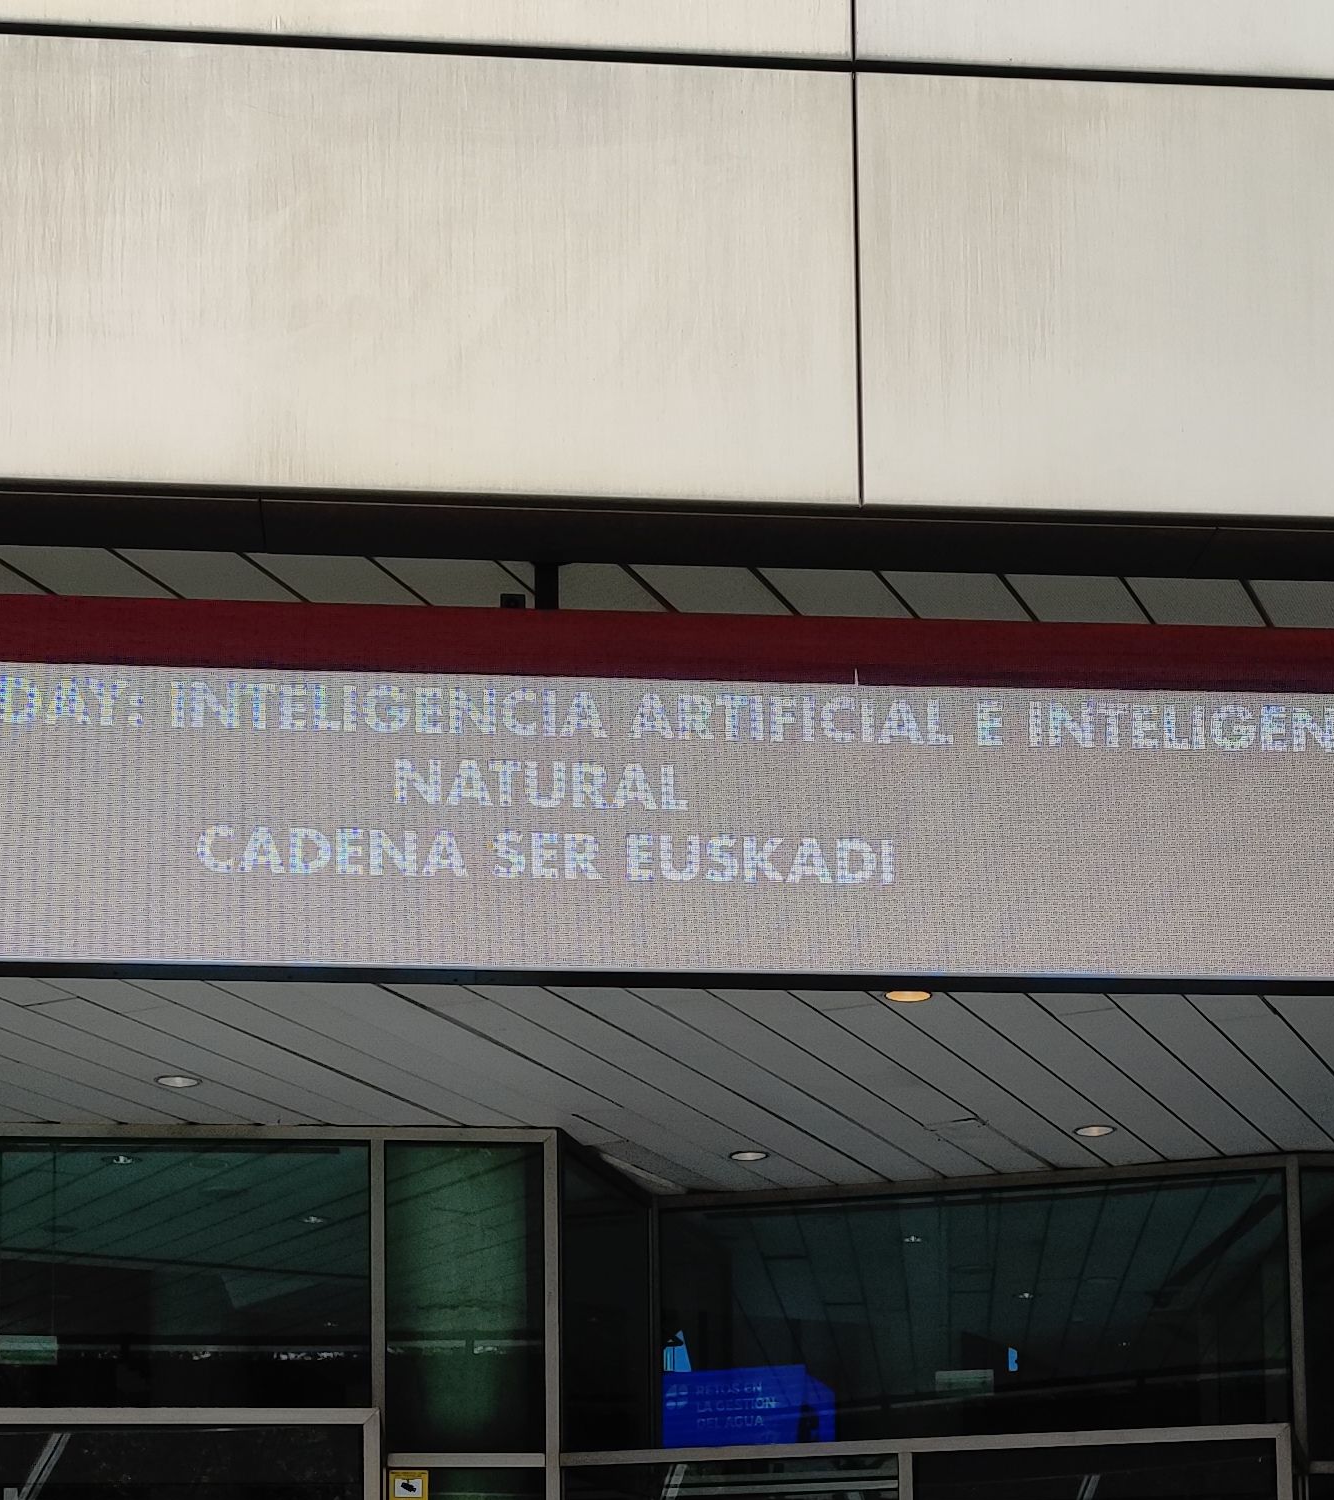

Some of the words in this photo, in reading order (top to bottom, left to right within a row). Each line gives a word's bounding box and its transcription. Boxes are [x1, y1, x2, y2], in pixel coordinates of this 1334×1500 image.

[171, 681, 607, 739] INTELIGENCIA
[629, 693, 954, 745] ARTIFICIAL
[977, 700, 1004, 747] E
[394, 758, 688, 811] NATURAL
[195, 825, 467, 877] CADENA
[493, 830, 599, 880] SER
[626, 834, 895, 885] EUSKADI
